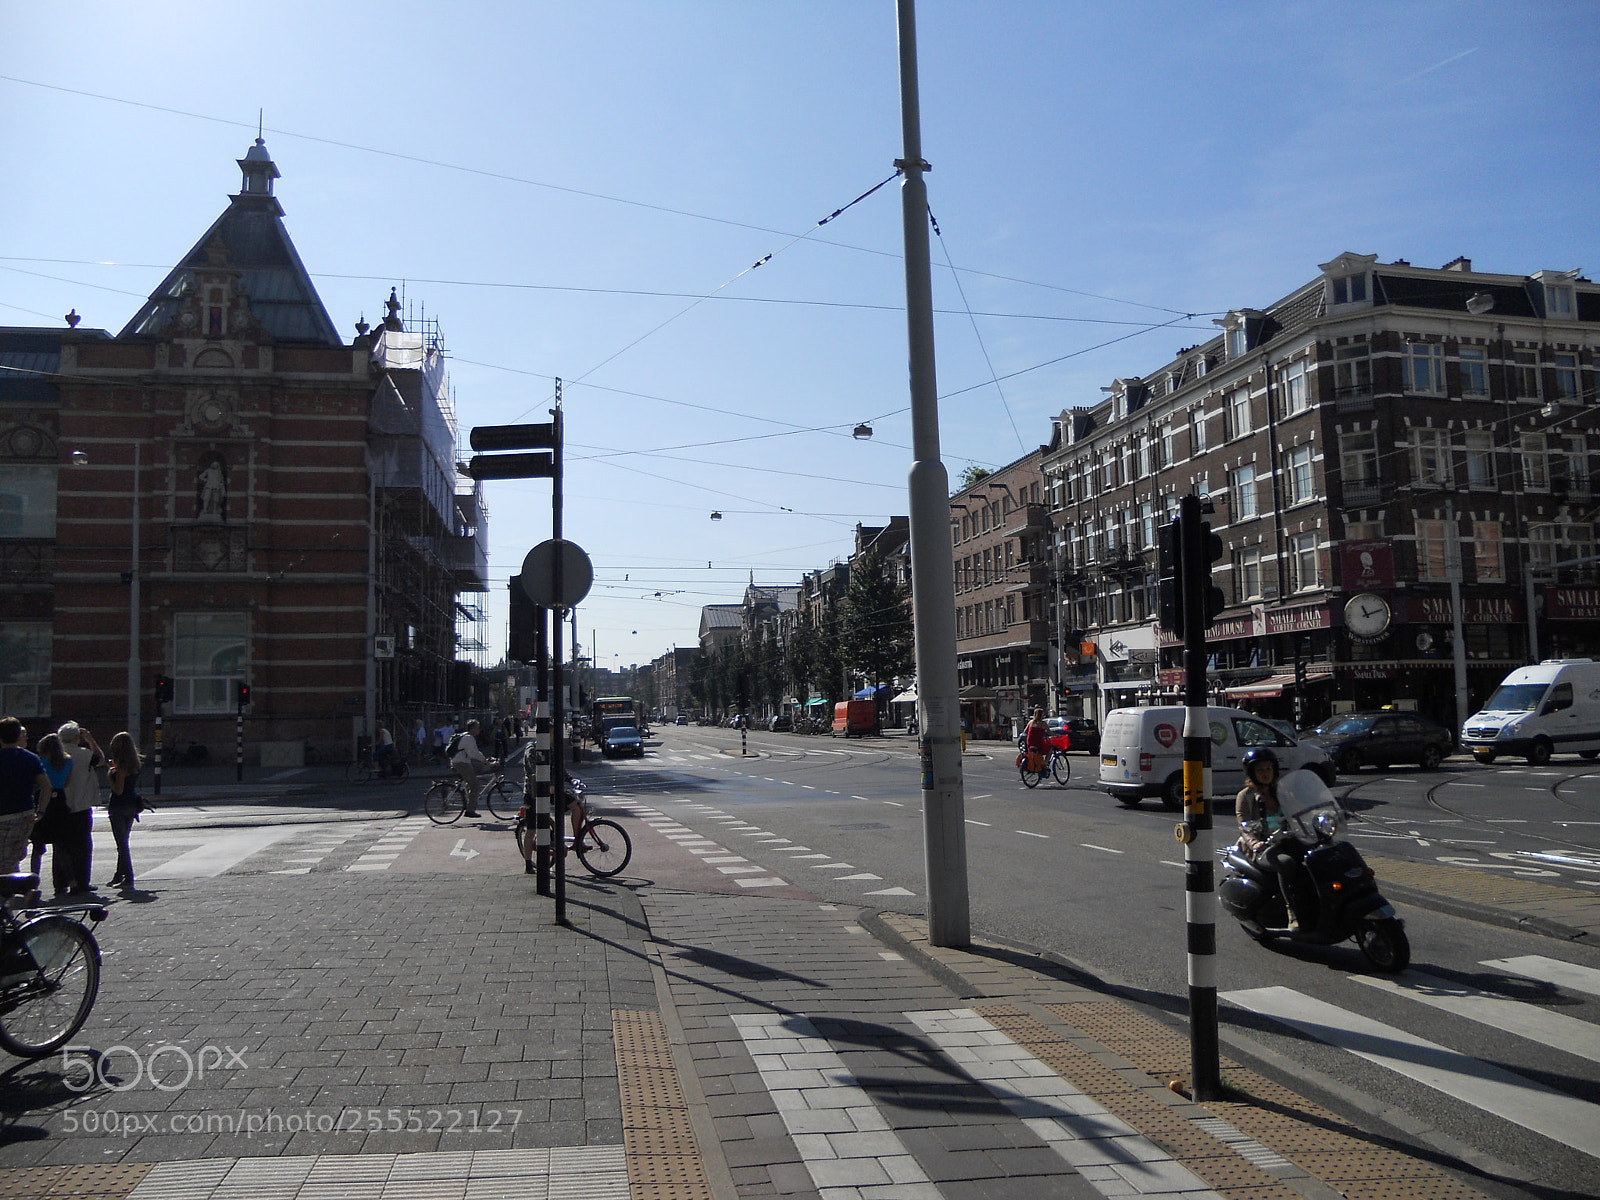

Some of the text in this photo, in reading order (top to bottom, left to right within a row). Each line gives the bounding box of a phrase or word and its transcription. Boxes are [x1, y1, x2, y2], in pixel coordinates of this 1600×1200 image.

[1423, 599, 1513, 614] SMAL TALK
[1270, 605, 1322, 625] SMALL TALK
[1429, 613, 1512, 622] COFFE CORNER
[1223, 621, 1246, 636] HOUSE
[1273, 619, 1321, 632] COFFEE CORNER
